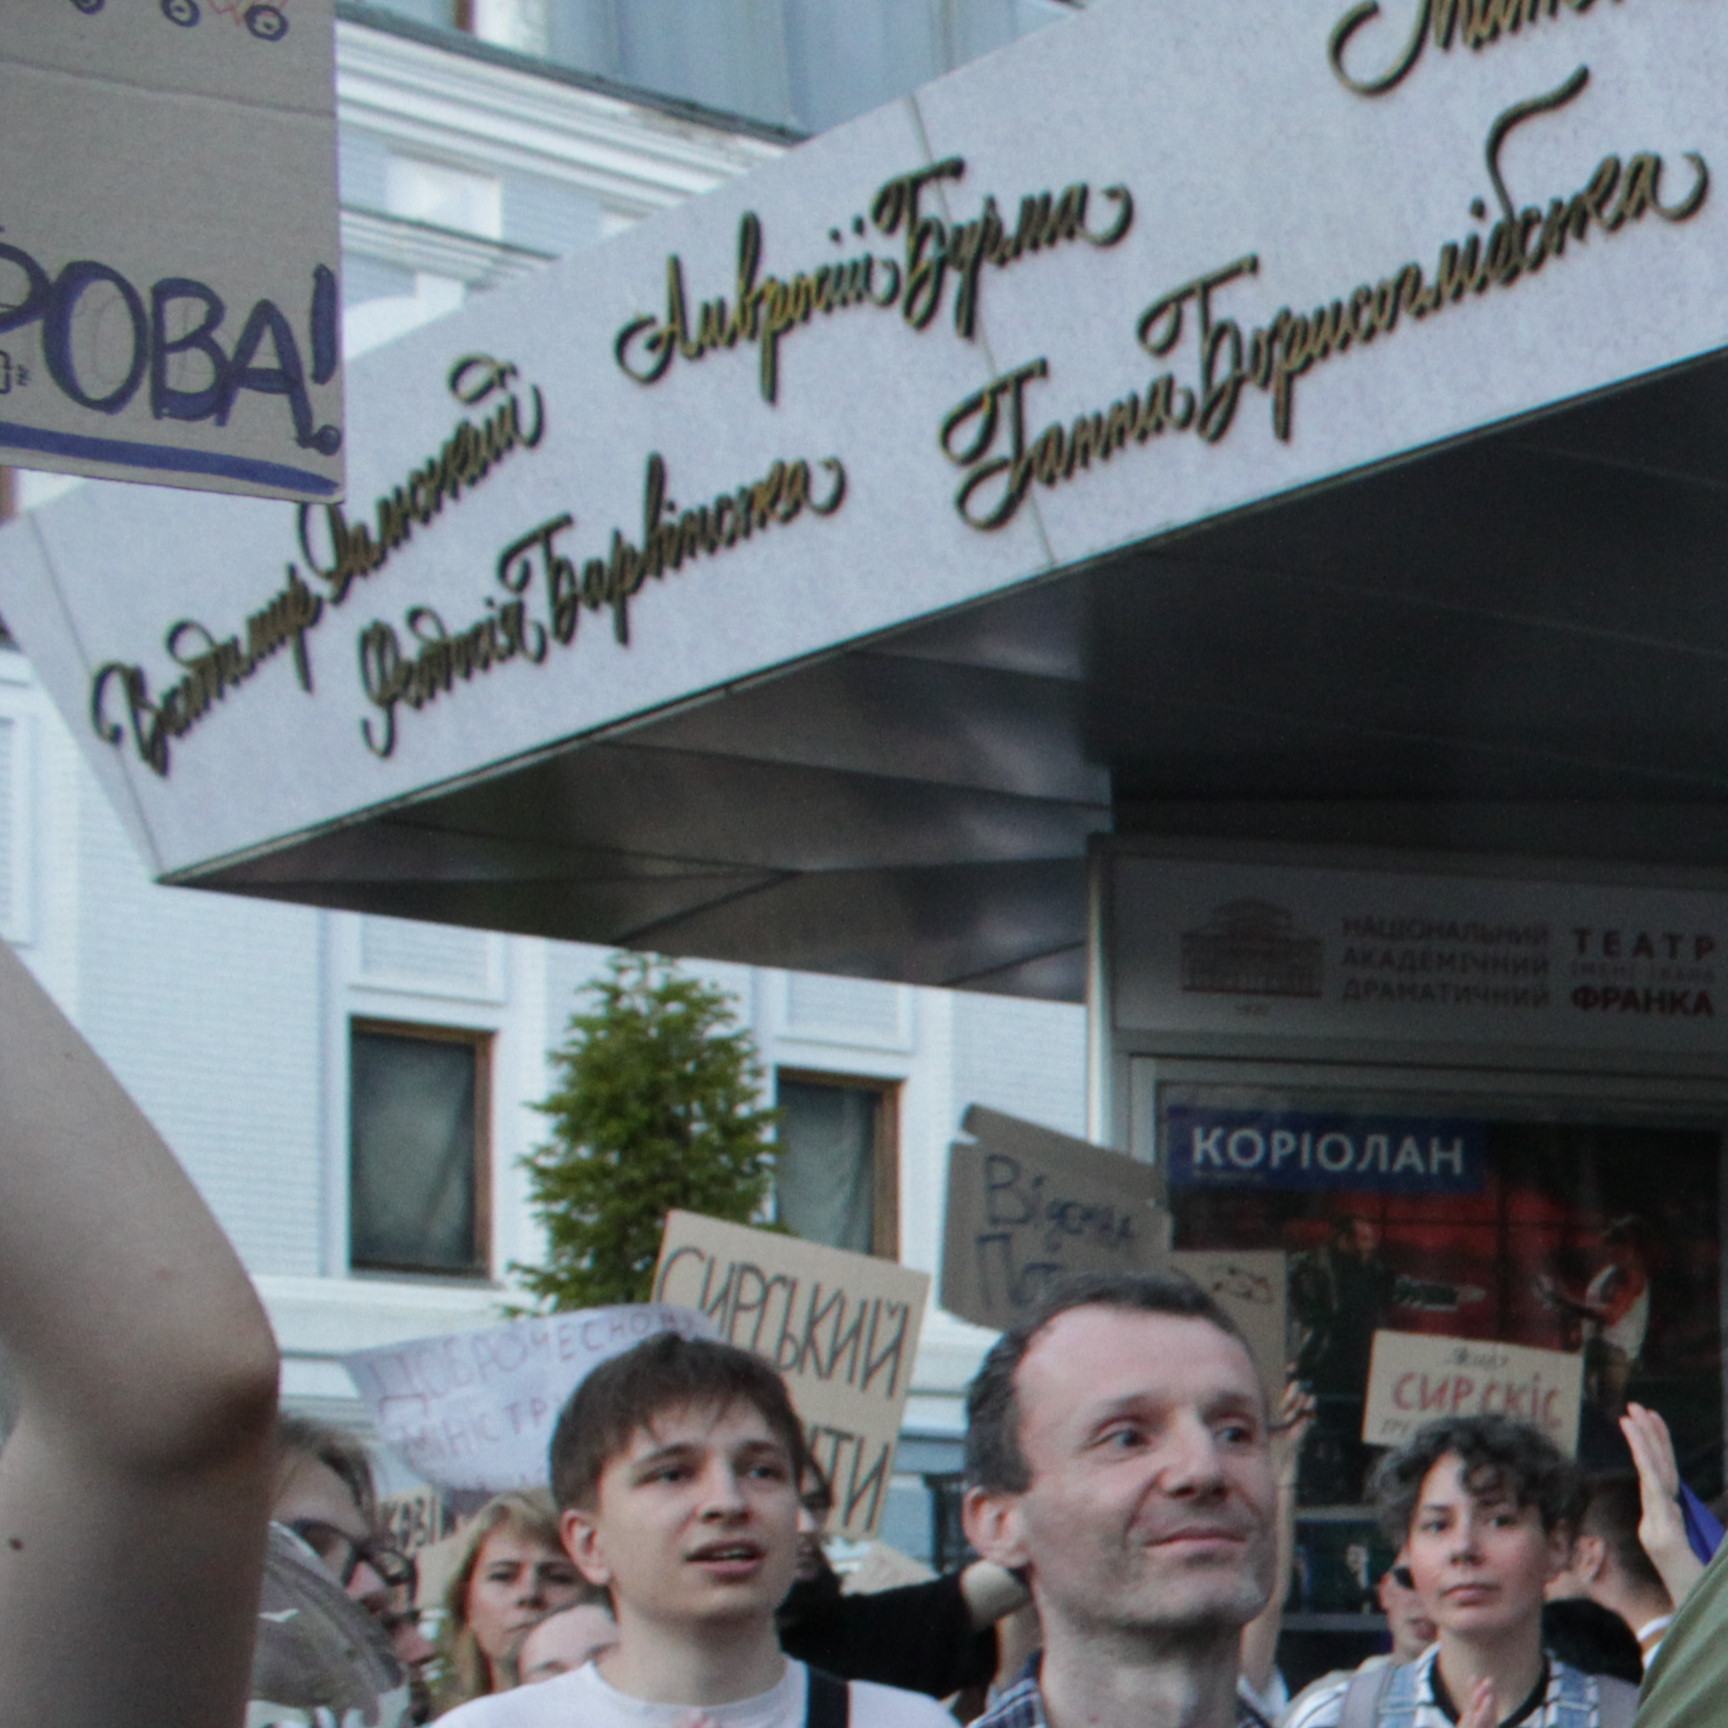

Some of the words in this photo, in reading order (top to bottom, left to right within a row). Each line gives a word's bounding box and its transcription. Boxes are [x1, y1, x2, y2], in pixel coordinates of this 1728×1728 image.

[1571, 926, 1717, 962] ТЕАТР
[1570, 983, 1716, 1018] ФРАНКА
[1191, 1125, 1466, 1177] КОРІОЛАН
